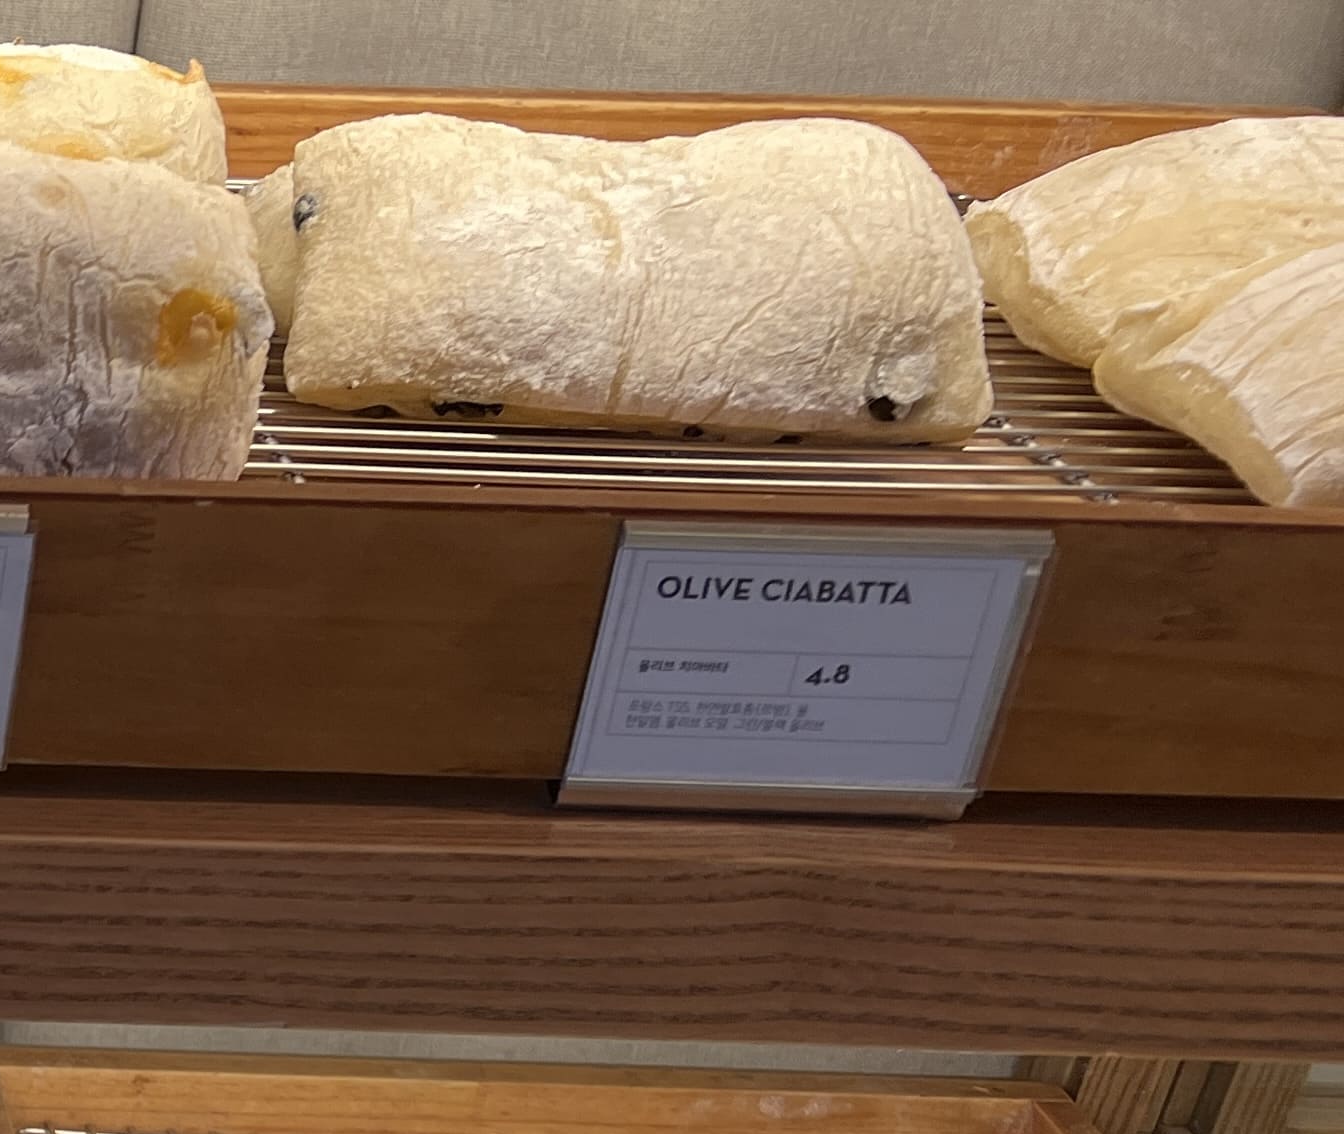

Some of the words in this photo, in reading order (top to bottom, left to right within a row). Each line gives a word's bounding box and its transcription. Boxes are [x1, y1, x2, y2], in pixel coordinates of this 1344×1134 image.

[657, 576, 754, 601] OLIVE
[761, 580, 912, 604] CIABATTA
[805, 664, 851, 685] 4.8
